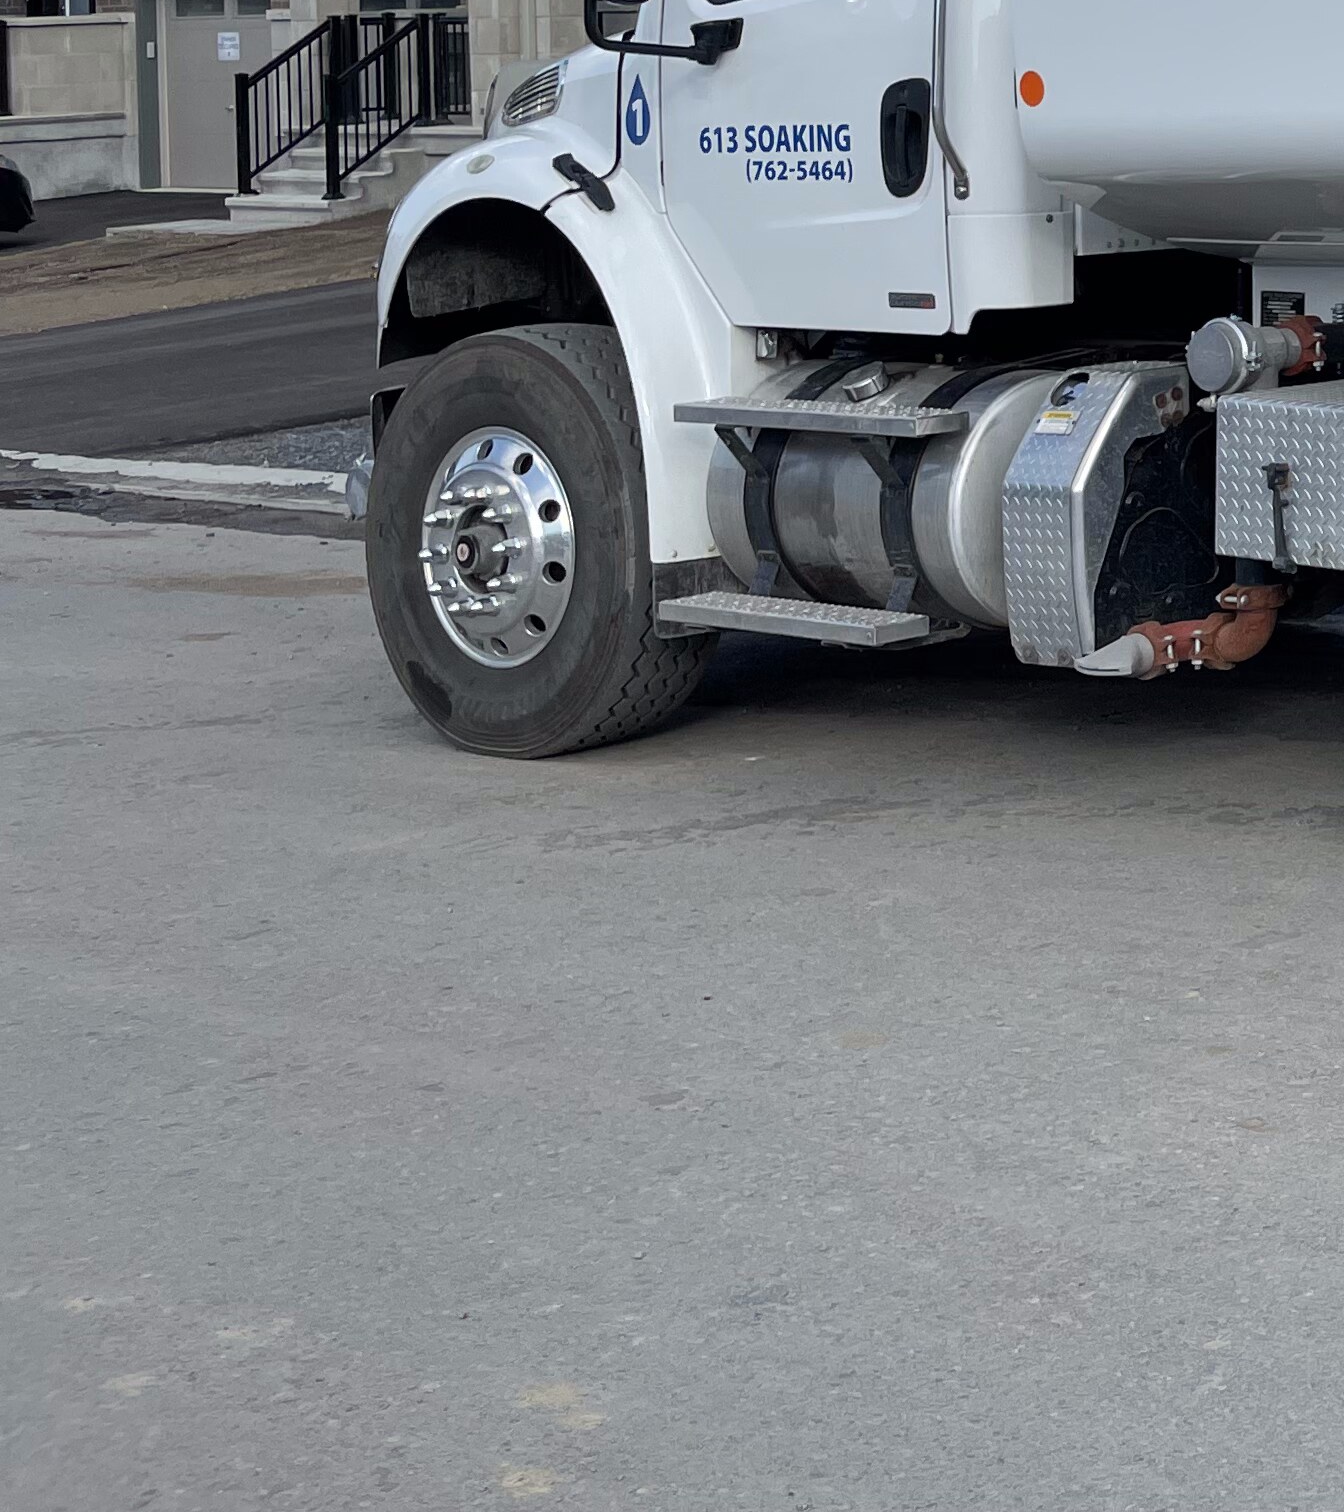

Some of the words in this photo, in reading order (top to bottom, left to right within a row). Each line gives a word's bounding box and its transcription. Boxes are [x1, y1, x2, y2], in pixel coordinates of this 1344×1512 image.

[631, 98, 644, 137] 1
[699, 126, 739, 154] 613
[744, 123, 851, 154] SOAKING
[746, 158, 853, 183] (762-5464)
